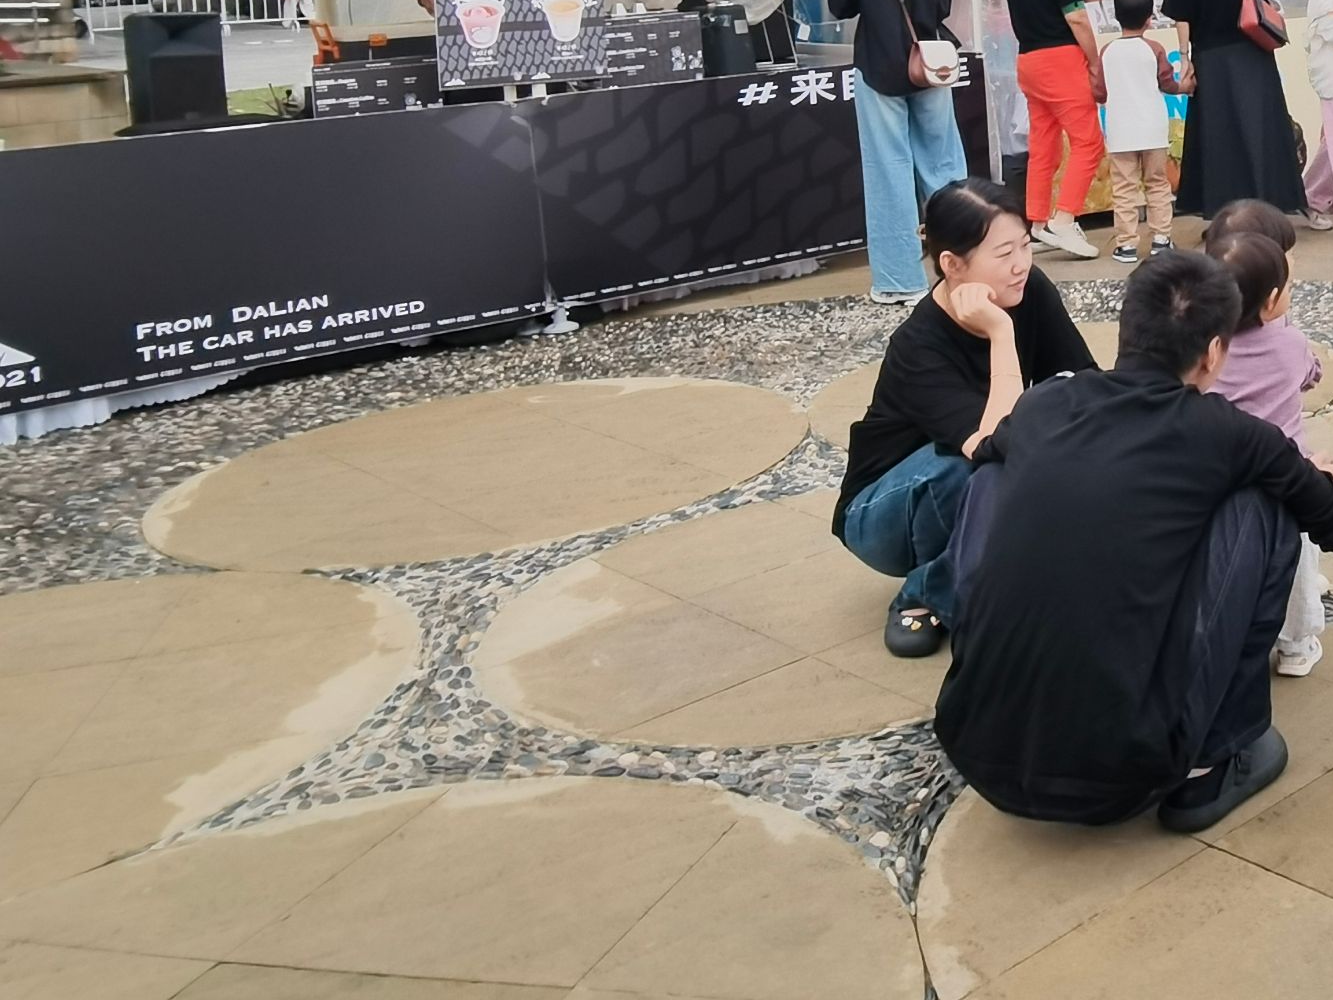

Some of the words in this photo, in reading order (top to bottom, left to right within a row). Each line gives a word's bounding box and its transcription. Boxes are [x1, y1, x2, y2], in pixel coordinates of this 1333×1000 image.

[136, 314, 213, 341] FROM
[136, 341, 194, 362] THE
[202, 330, 254, 350] CAR
[264, 319, 313, 340] HAS
[321, 300, 426, 330] ARRIVED
[0, 366, 41, 388] 21
